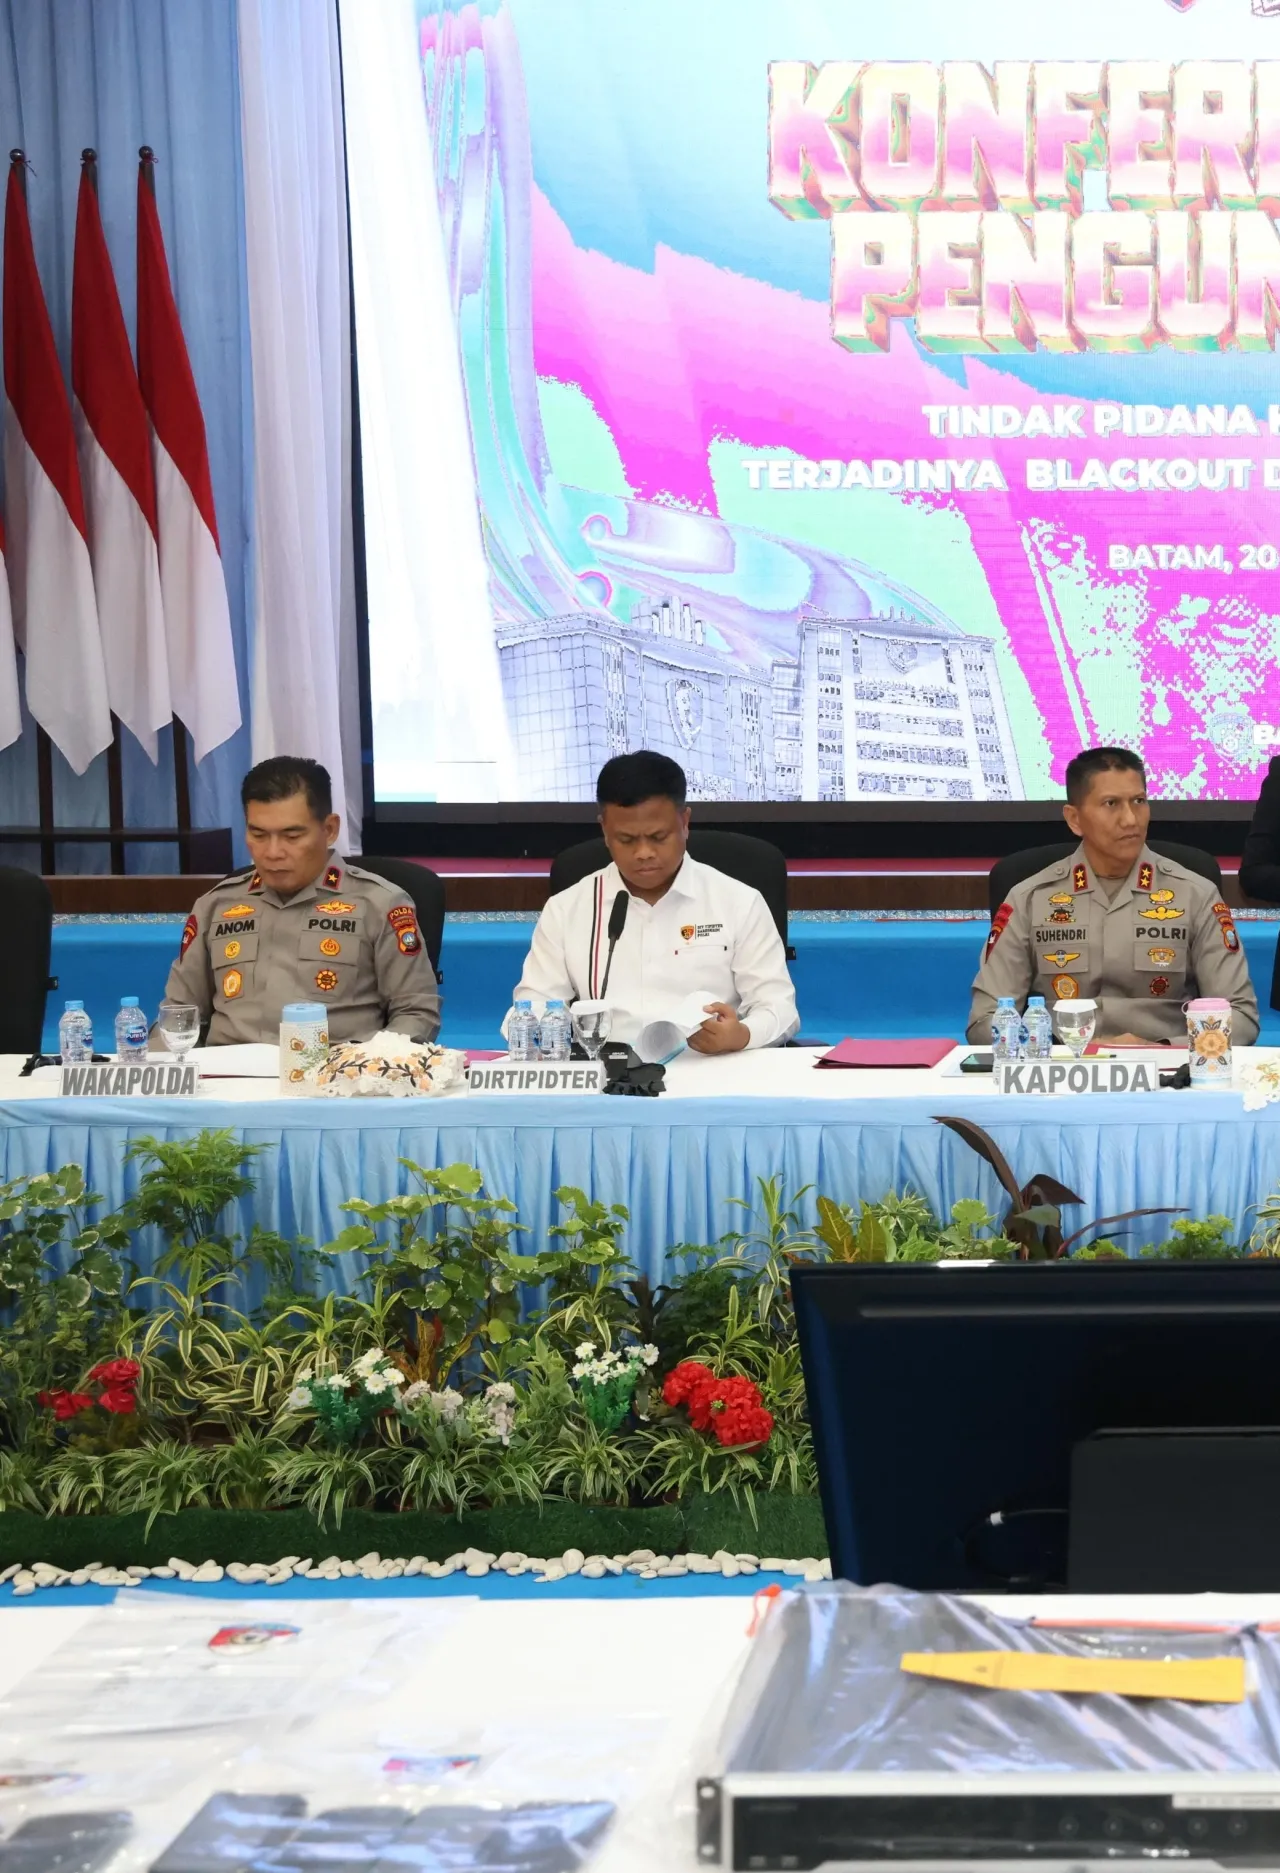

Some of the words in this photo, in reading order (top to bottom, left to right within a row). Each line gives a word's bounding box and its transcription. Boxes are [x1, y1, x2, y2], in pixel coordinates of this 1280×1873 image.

[922, 404, 1087, 438] TINDAK
[1093, 404, 1259, 438] PIDANA
[741, 458, 1008, 492] TERJADINYA
[1025, 457, 1259, 491] BLACKOUT
[1107, 543, 1234, 575] BATAM,
[1239, 543, 1280, 571] 20
[215, 919, 255, 936] ANOM
[308, 918, 357, 933] POLRI
[1036, 928, 1087, 943] SUHENDRI
[1135, 927, 1187, 940] POLRI
[62, 1066, 195, 1096] WAKAPOLDA
[470, 1069, 599, 1090] DIRTIPIDTER
[1004, 1064, 1151, 1094] KAPOLDA
